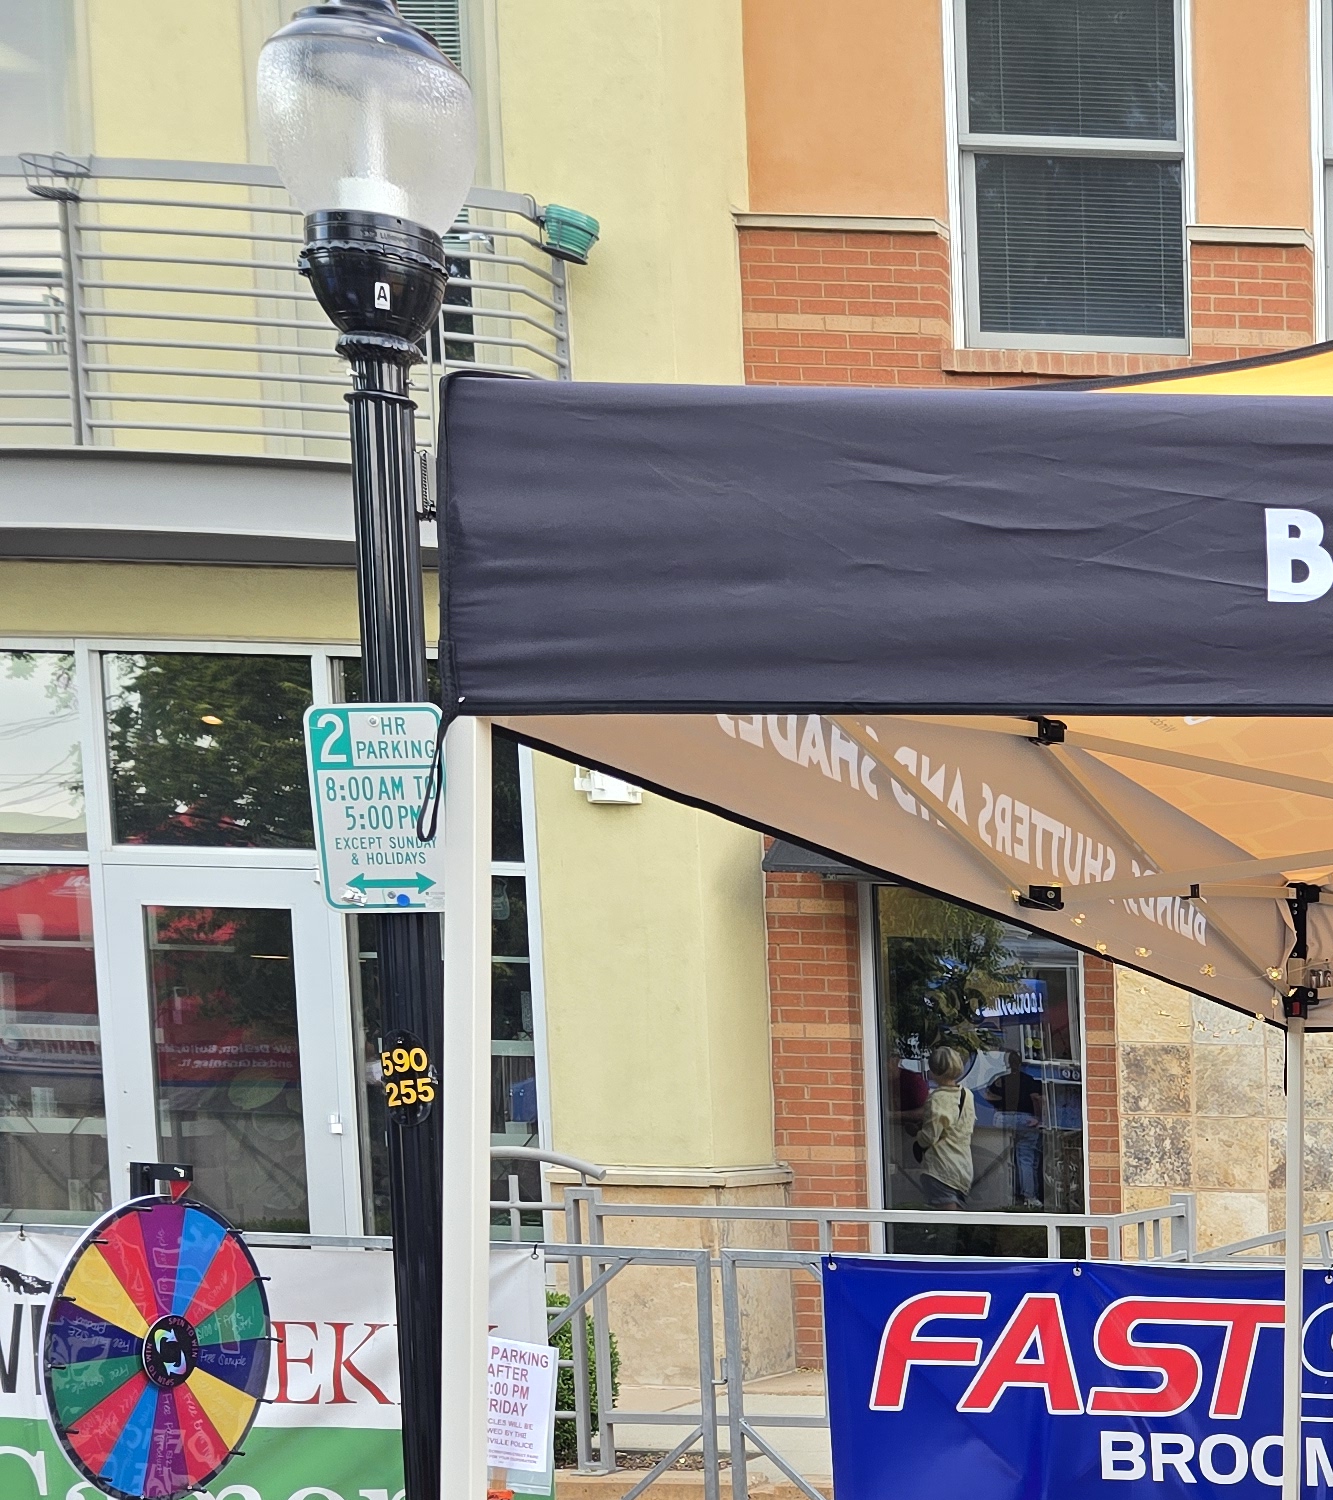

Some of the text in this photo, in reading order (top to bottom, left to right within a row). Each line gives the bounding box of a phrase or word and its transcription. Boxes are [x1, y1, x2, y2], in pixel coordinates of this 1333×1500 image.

[380, 717, 406, 735] HR
[317, 713, 347, 763] 2
[356, 739, 435, 759] PARKING
[325, 776, 374, 801] 8:00
[378, 775, 405, 800] AM
[345, 805, 394, 830] 5:00
[335, 836, 382, 849] EXCEPT
[366, 852, 426, 865] HOLIDAYS
[381, 1047, 428, 1076] 590
[385, 1077, 435, 1107] 255
[167, 1317, 186, 1328] SPIN
[491, 1345, 549, 1369] PARKING
[488, 1363, 528, 1382] AFTER
[488, 1381, 530, 1400] :00 PM
[488, 1398, 528, 1417] RIDAY
